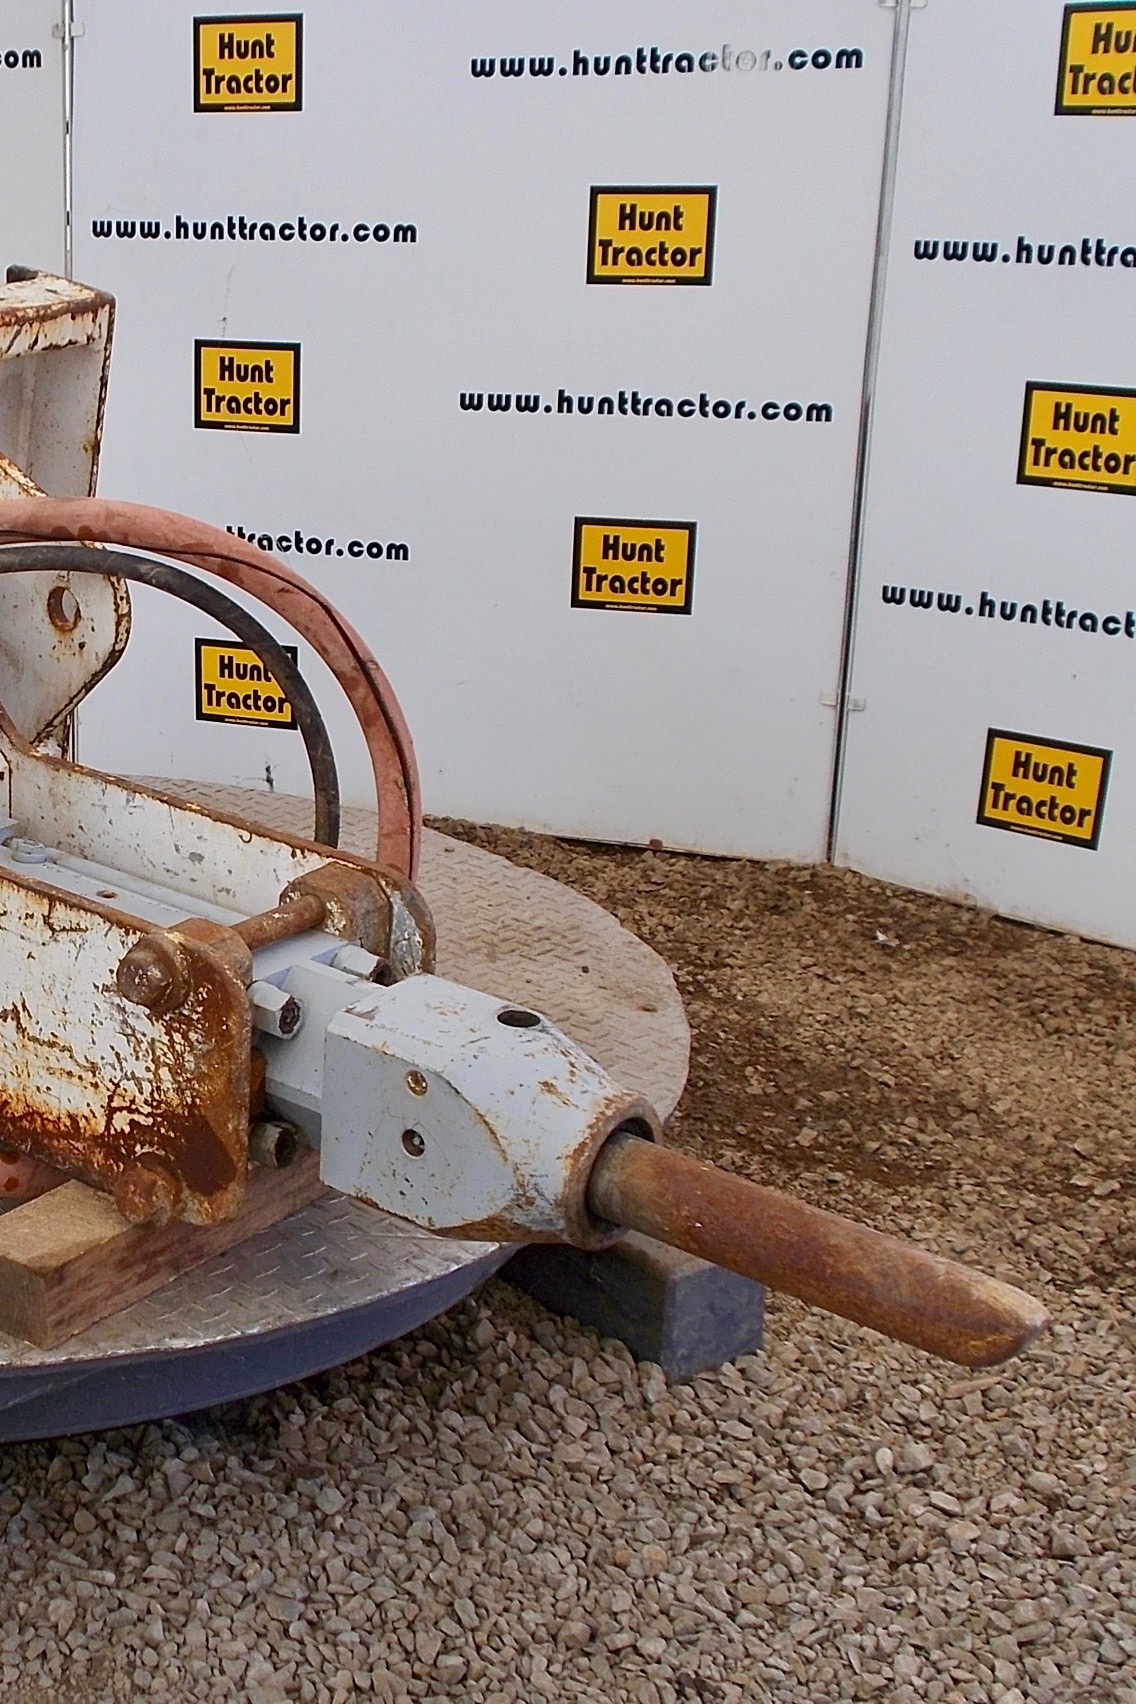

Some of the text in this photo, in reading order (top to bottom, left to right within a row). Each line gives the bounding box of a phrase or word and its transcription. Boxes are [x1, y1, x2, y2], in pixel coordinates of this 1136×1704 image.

[219, 33, 274, 59] Hunt
[1092, 23, 1136, 54] Hu
[203, 68, 292, 95] Tractor
[1069, 64, 1136, 95] Trac
[92, 215, 417, 243] www.hunttractor.com
[619, 204, 683, 231] Hunt
[598, 239, 702, 267] Tractor
[220, 356, 273, 383] Hunt
[204, 387, 291, 417] Tractor
[460, 389, 832, 422] www.hunttractor.com
[1053, 402, 1119, 435] Hunt
[1030, 439, 1136, 475] Tractor
[602, 535, 664, 562] Hunt
[582, 566, 683, 597] Tractor
[203, 683, 286, 714] Tractor
[1012, 750, 1079, 790] Hunt
[990, 781, 1092, 828] Tractor
